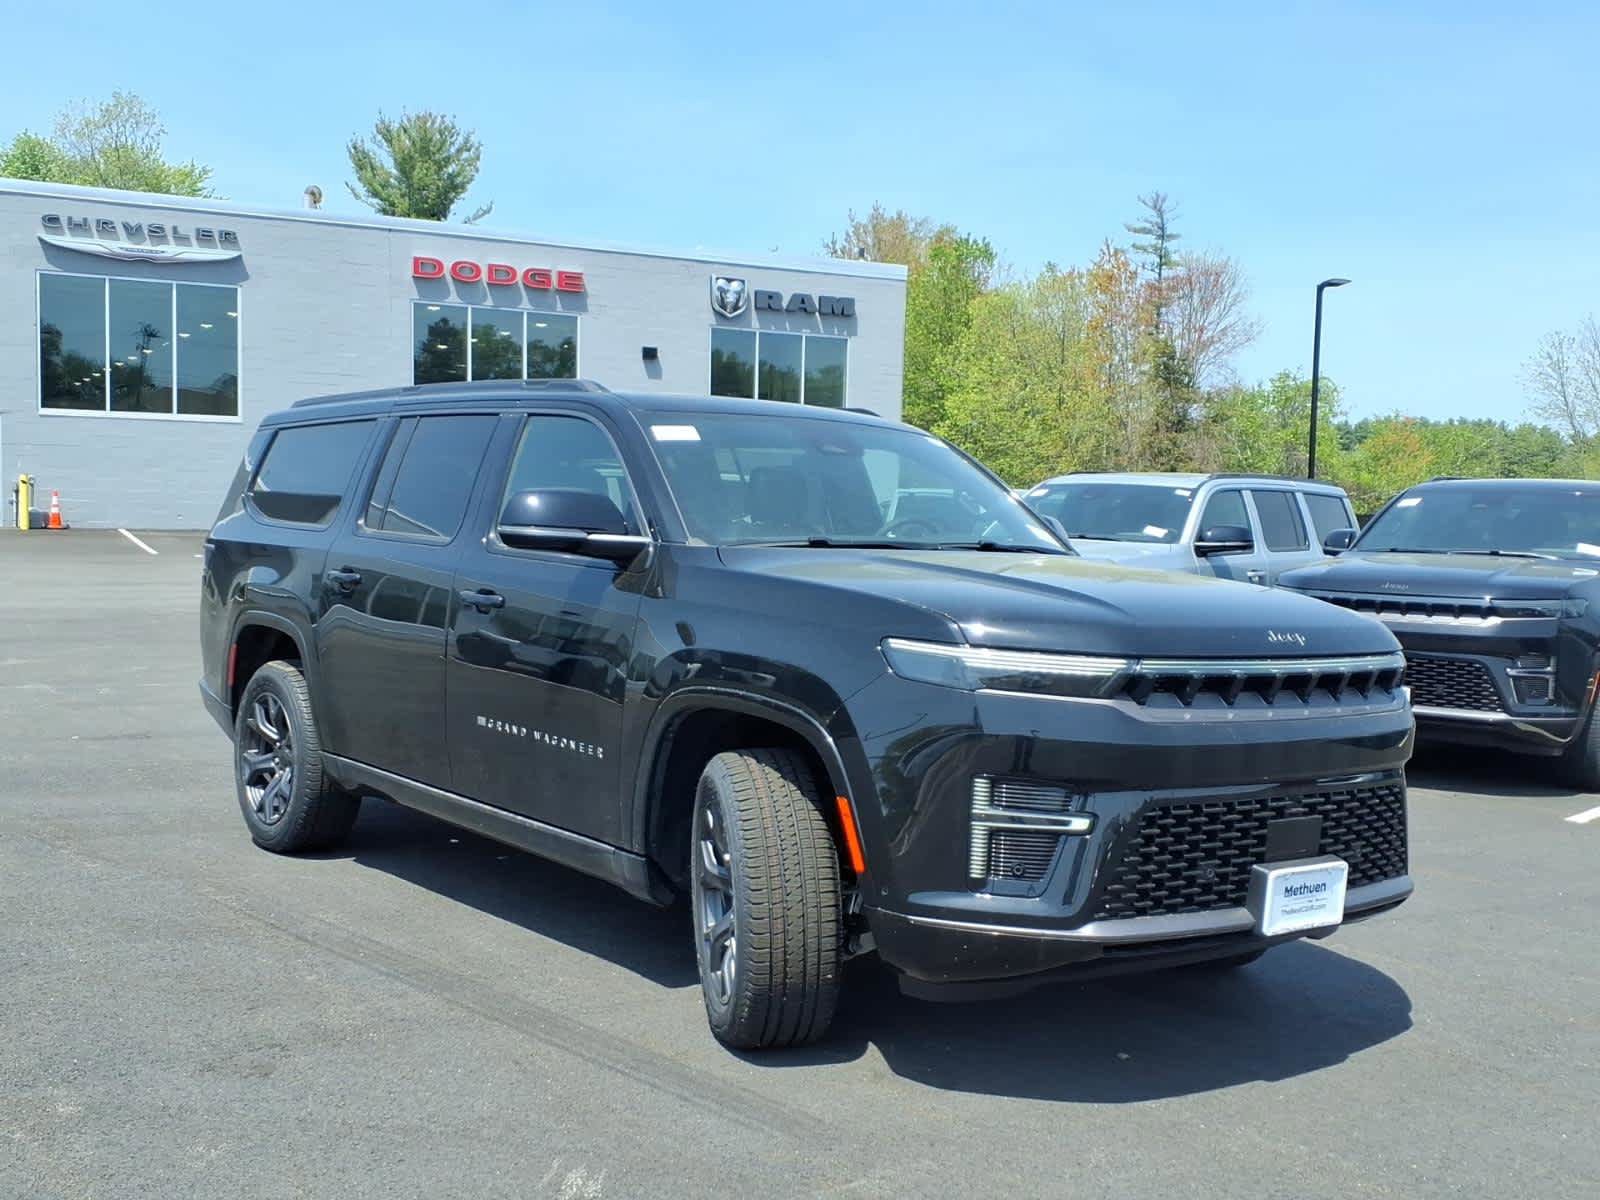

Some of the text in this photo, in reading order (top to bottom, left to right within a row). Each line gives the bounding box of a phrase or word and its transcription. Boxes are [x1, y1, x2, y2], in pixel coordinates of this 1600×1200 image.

[41, 213, 238, 243] CHRYSLER
[412, 256, 585, 293] DODGE
[754, 289, 856, 317] RAM
[487, 718, 604, 759] GRAND WAGONEER
[1283, 882, 1327, 898] Methuen
